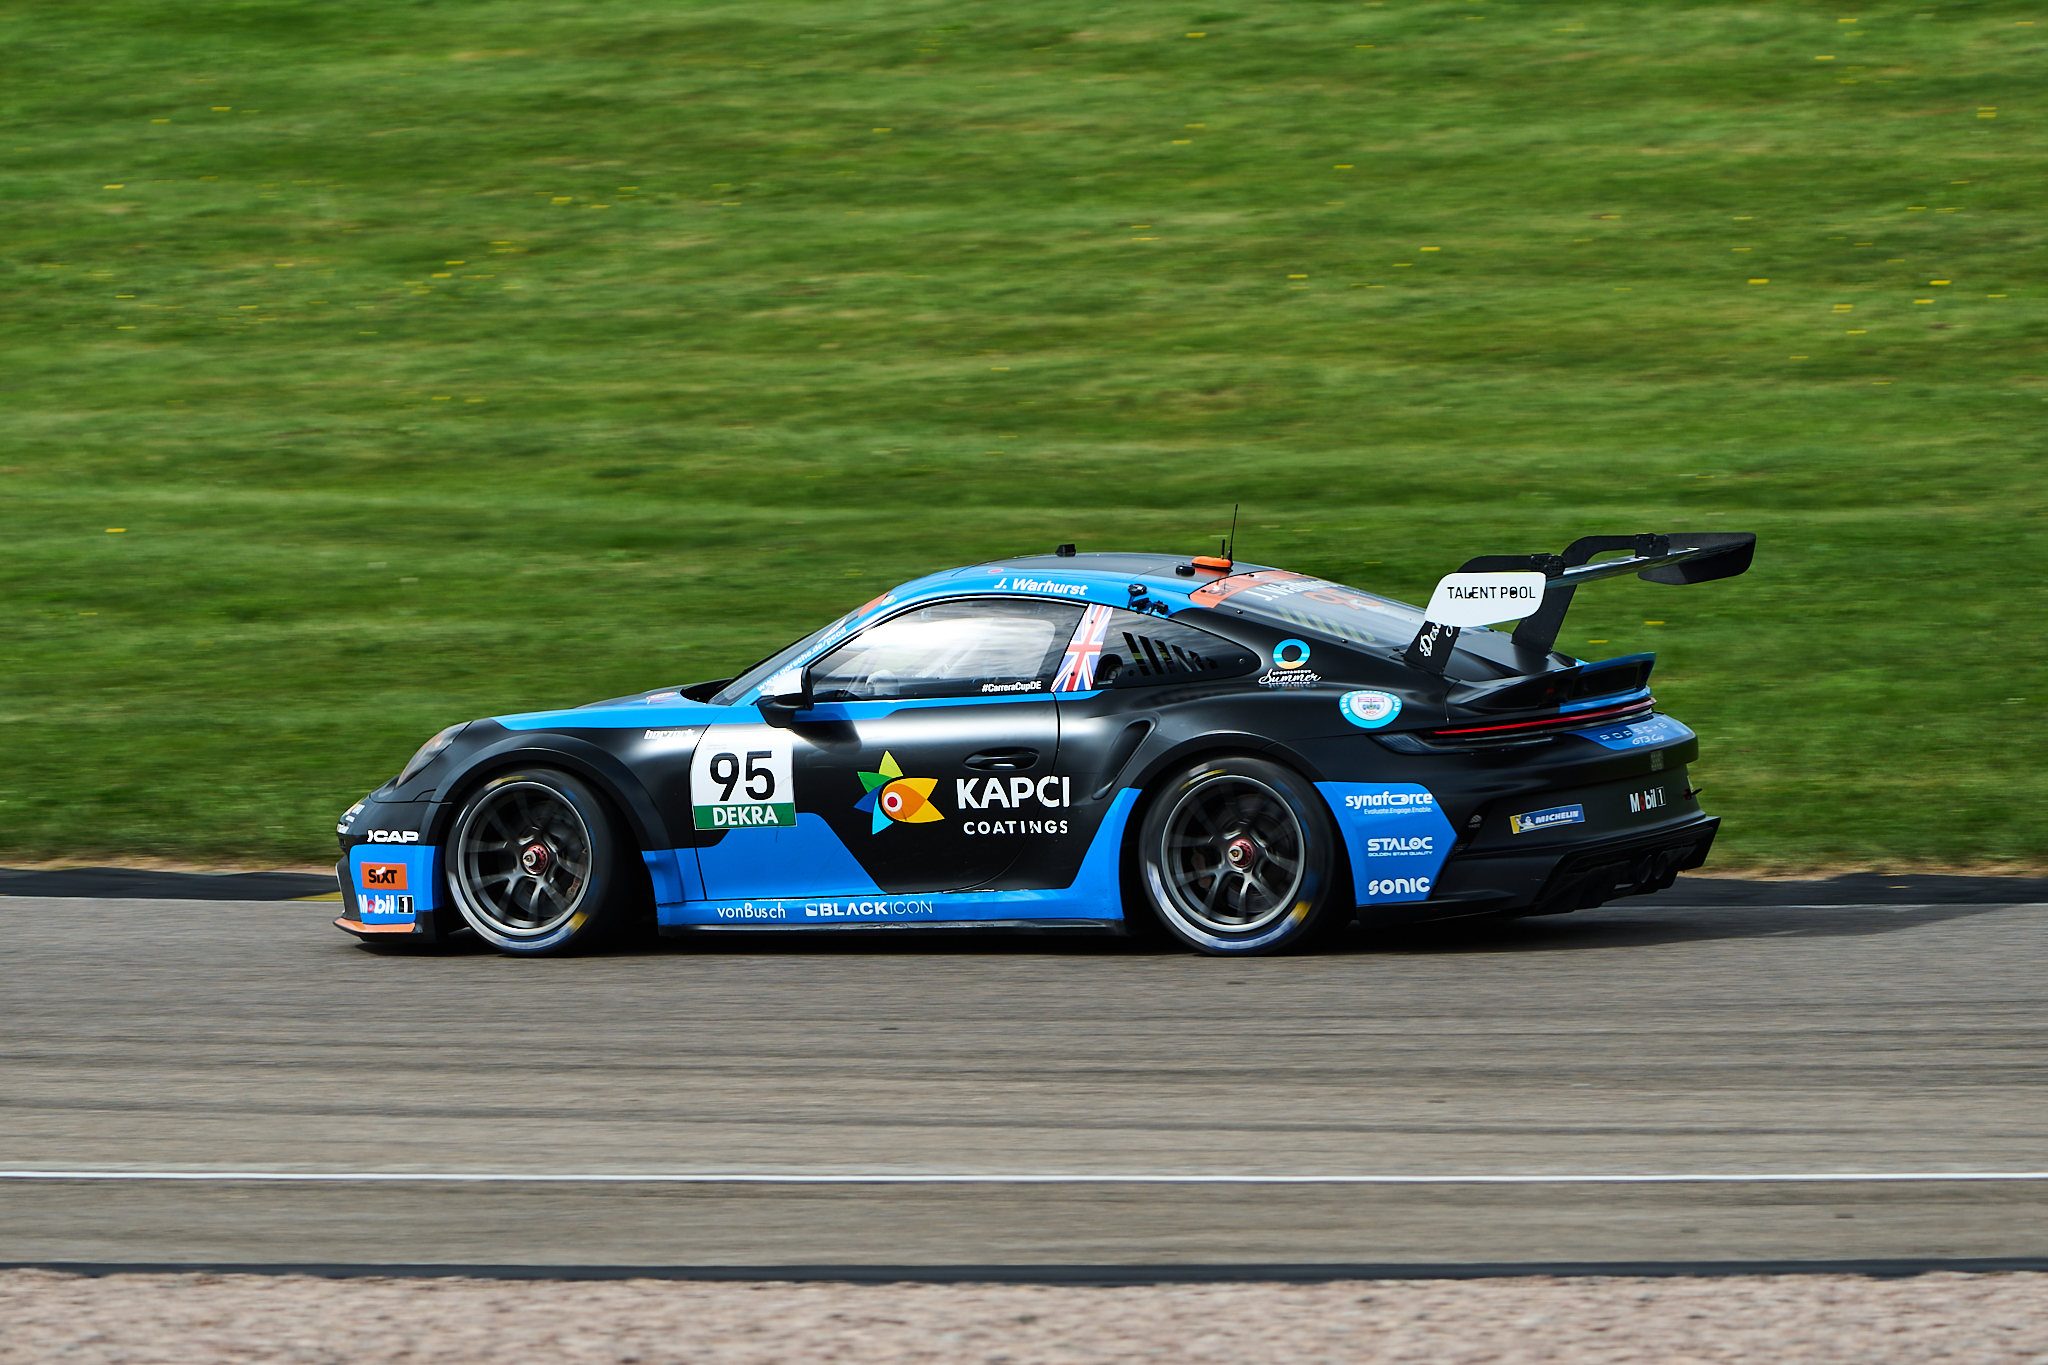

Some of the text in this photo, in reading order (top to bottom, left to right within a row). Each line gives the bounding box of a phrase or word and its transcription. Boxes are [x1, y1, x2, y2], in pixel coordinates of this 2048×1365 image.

[994, 578, 1088, 595] J. Warhurst
[1447, 586, 1536, 599] TALENT POOL
[757, 626, 847, 692] www.porsche.de/pccd
[1257, 667, 1322, 685] Summer
[981, 680, 1042, 693] #CarreraCupDE
[1599, 722, 1669, 741] PORSCHE
[1632, 735, 1651, 745] GT3
[709, 750, 776, 802] 95
[956, 775, 1070, 809] KAPCI
[1629, 789, 1658, 813] Mobil
[712, 805, 779, 826] DEKRA
[1535, 810, 1579, 824] MICHELIN
[963, 820, 1068, 835] COATINGS
[1367, 836, 1433, 851] STALOC
[357, 894, 395, 914] Mobil
[717, 902, 786, 919] vonBusch
